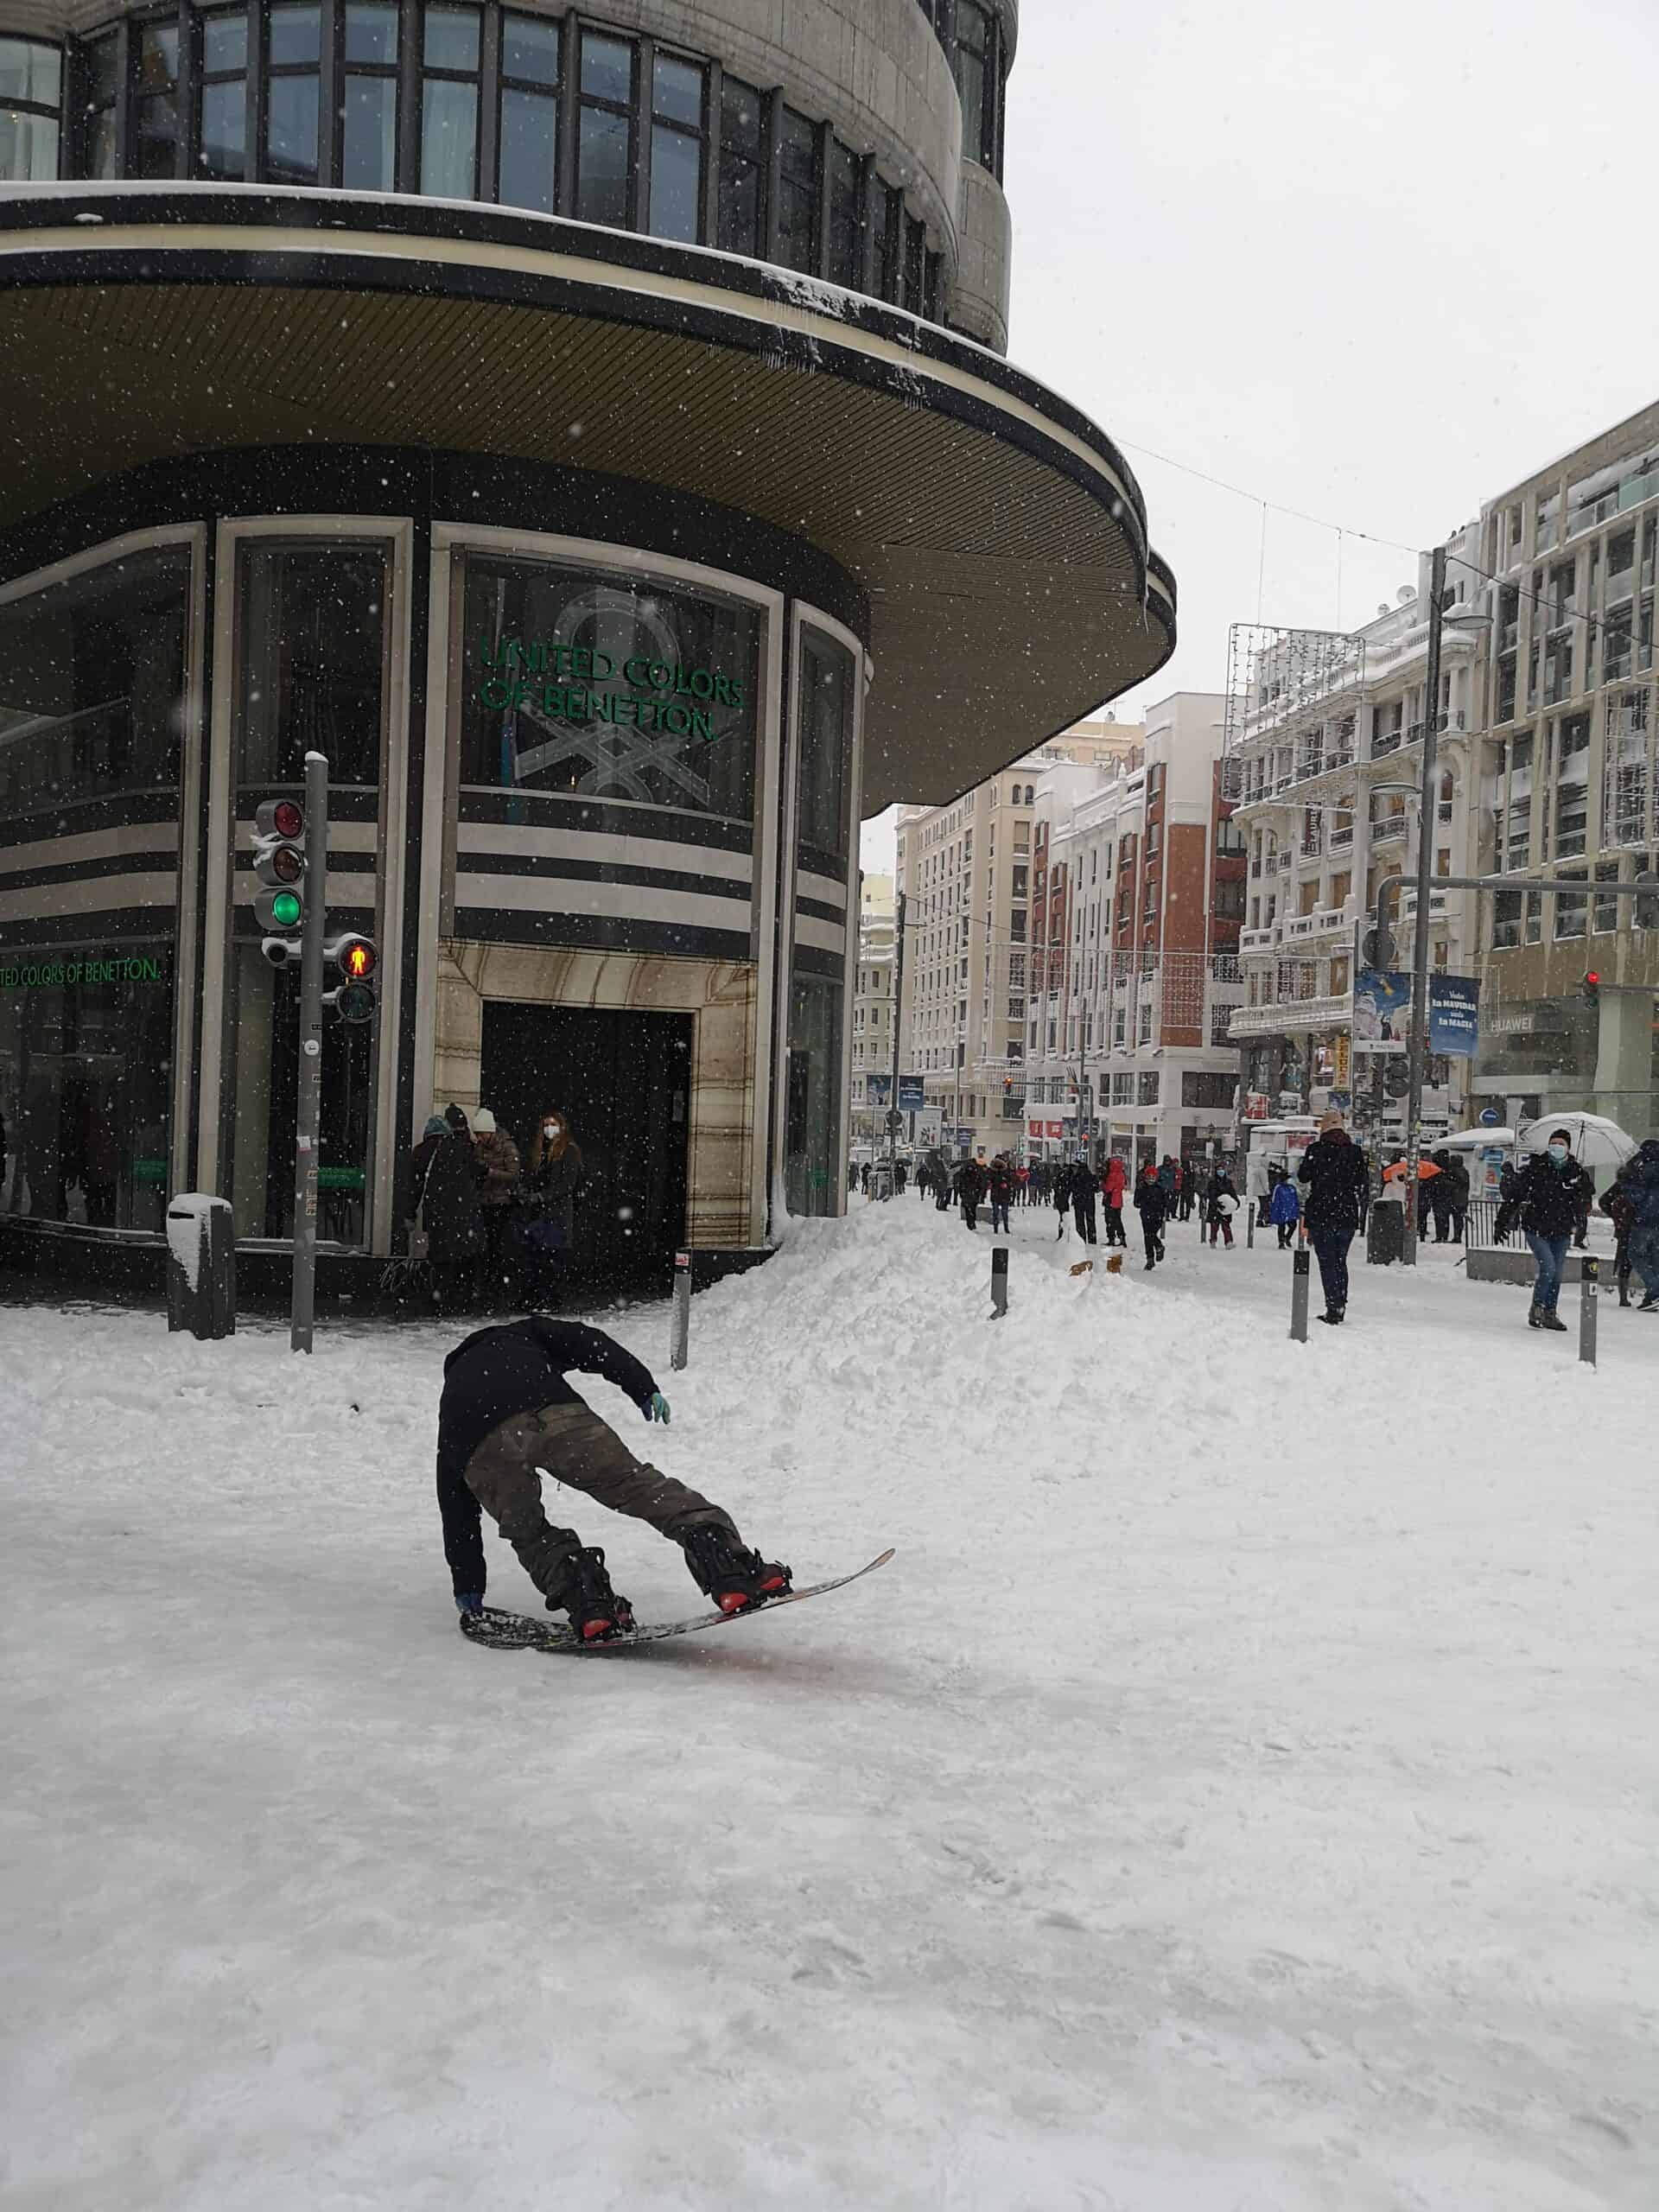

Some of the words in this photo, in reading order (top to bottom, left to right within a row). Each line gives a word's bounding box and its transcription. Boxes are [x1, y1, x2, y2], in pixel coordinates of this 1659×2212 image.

[480, 638, 615, 680] UNITED
[624, 657, 744, 708] COLORS
[480, 680, 532, 710] OF
[21, 966, 65, 986] COLORS
[67, 963, 82, 983] OF
[1491, 1017, 1533, 1032] HUAWEI
